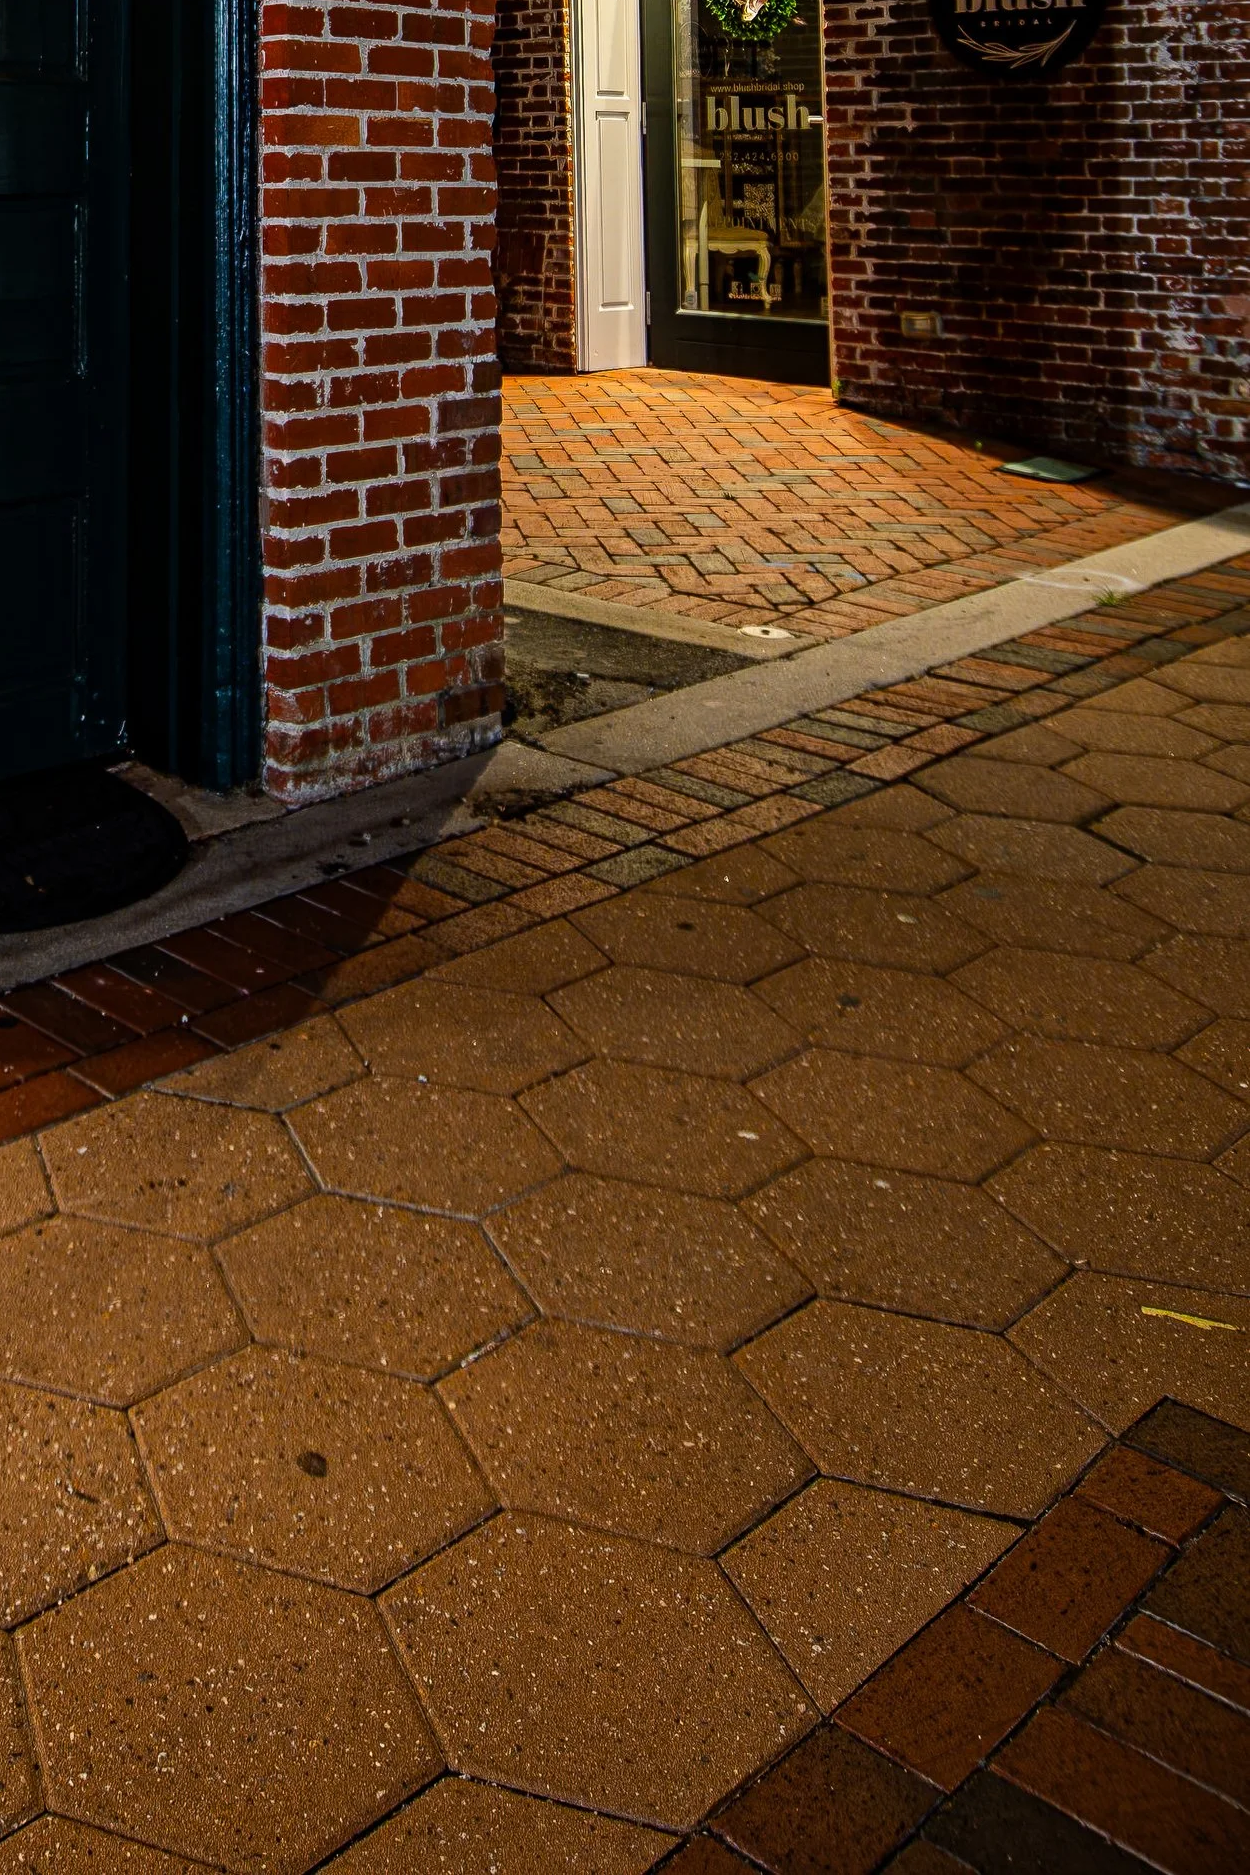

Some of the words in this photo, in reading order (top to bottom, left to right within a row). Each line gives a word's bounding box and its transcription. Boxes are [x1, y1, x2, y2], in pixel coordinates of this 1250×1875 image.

[980, 18, 1053, 28] BRIDAL
[710, 81, 806, 94] www.blushbridal.shop
[705, 94, 813, 131] blush
